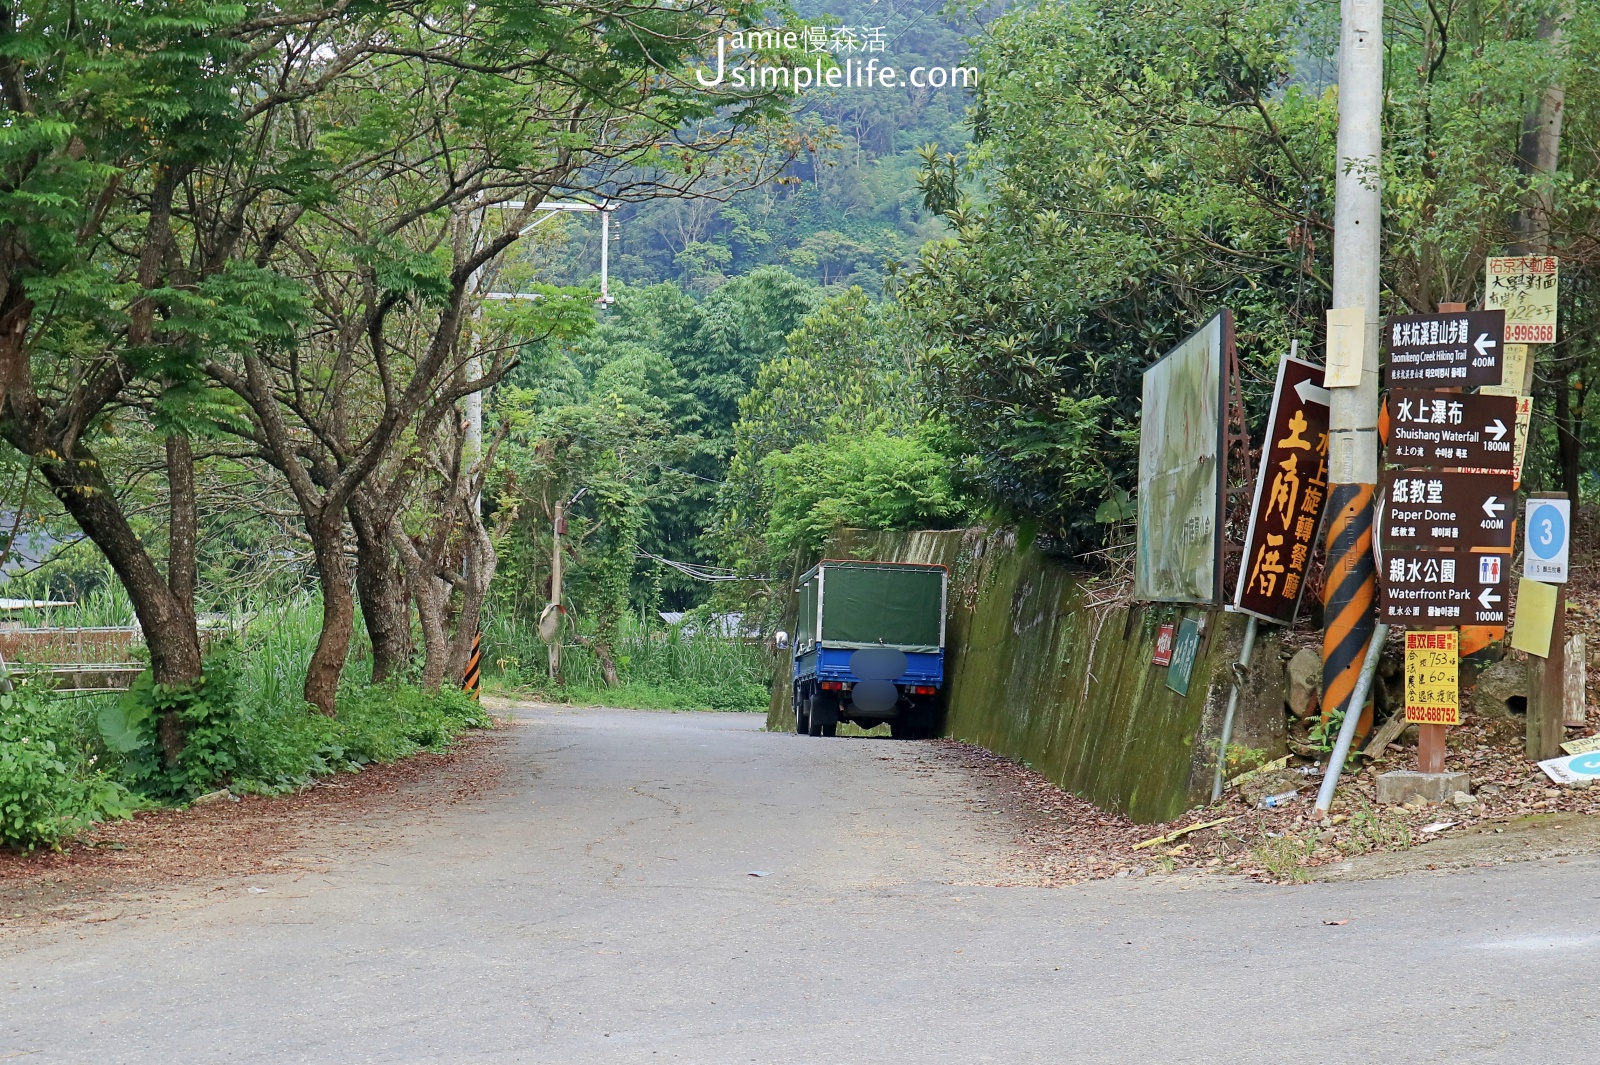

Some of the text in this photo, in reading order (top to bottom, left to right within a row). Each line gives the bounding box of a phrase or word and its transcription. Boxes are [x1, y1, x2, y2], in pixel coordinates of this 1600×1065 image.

[1393, 319, 1469, 347] 桃米坑溪登山步道
[1391, 349, 1467, 365] Taomikeng Creek Hiking Trail
[1472, 357, 1495, 367] 400M
[1397, 397, 1463, 425] 水上瀑布
[1395, 428, 1479, 443] Shuishang Waterfall
[1483, 441, 1510, 452] 1800M
[1392, 479, 1443, 504] 紙教堂
[1282, 432, 1329, 599] 水上旋轉餐廳
[1391, 509, 1456, 522] Paper Dome
[1480, 519, 1503, 529] 400M
[1540, 519, 1553, 545] 3
[1389, 558, 1456, 583] 親水公園
[1388, 588, 1471, 600] Waterfront Park
[1475, 611, 1503, 621] 1000M
[1407, 706, 1456, 722] 0932-688752
